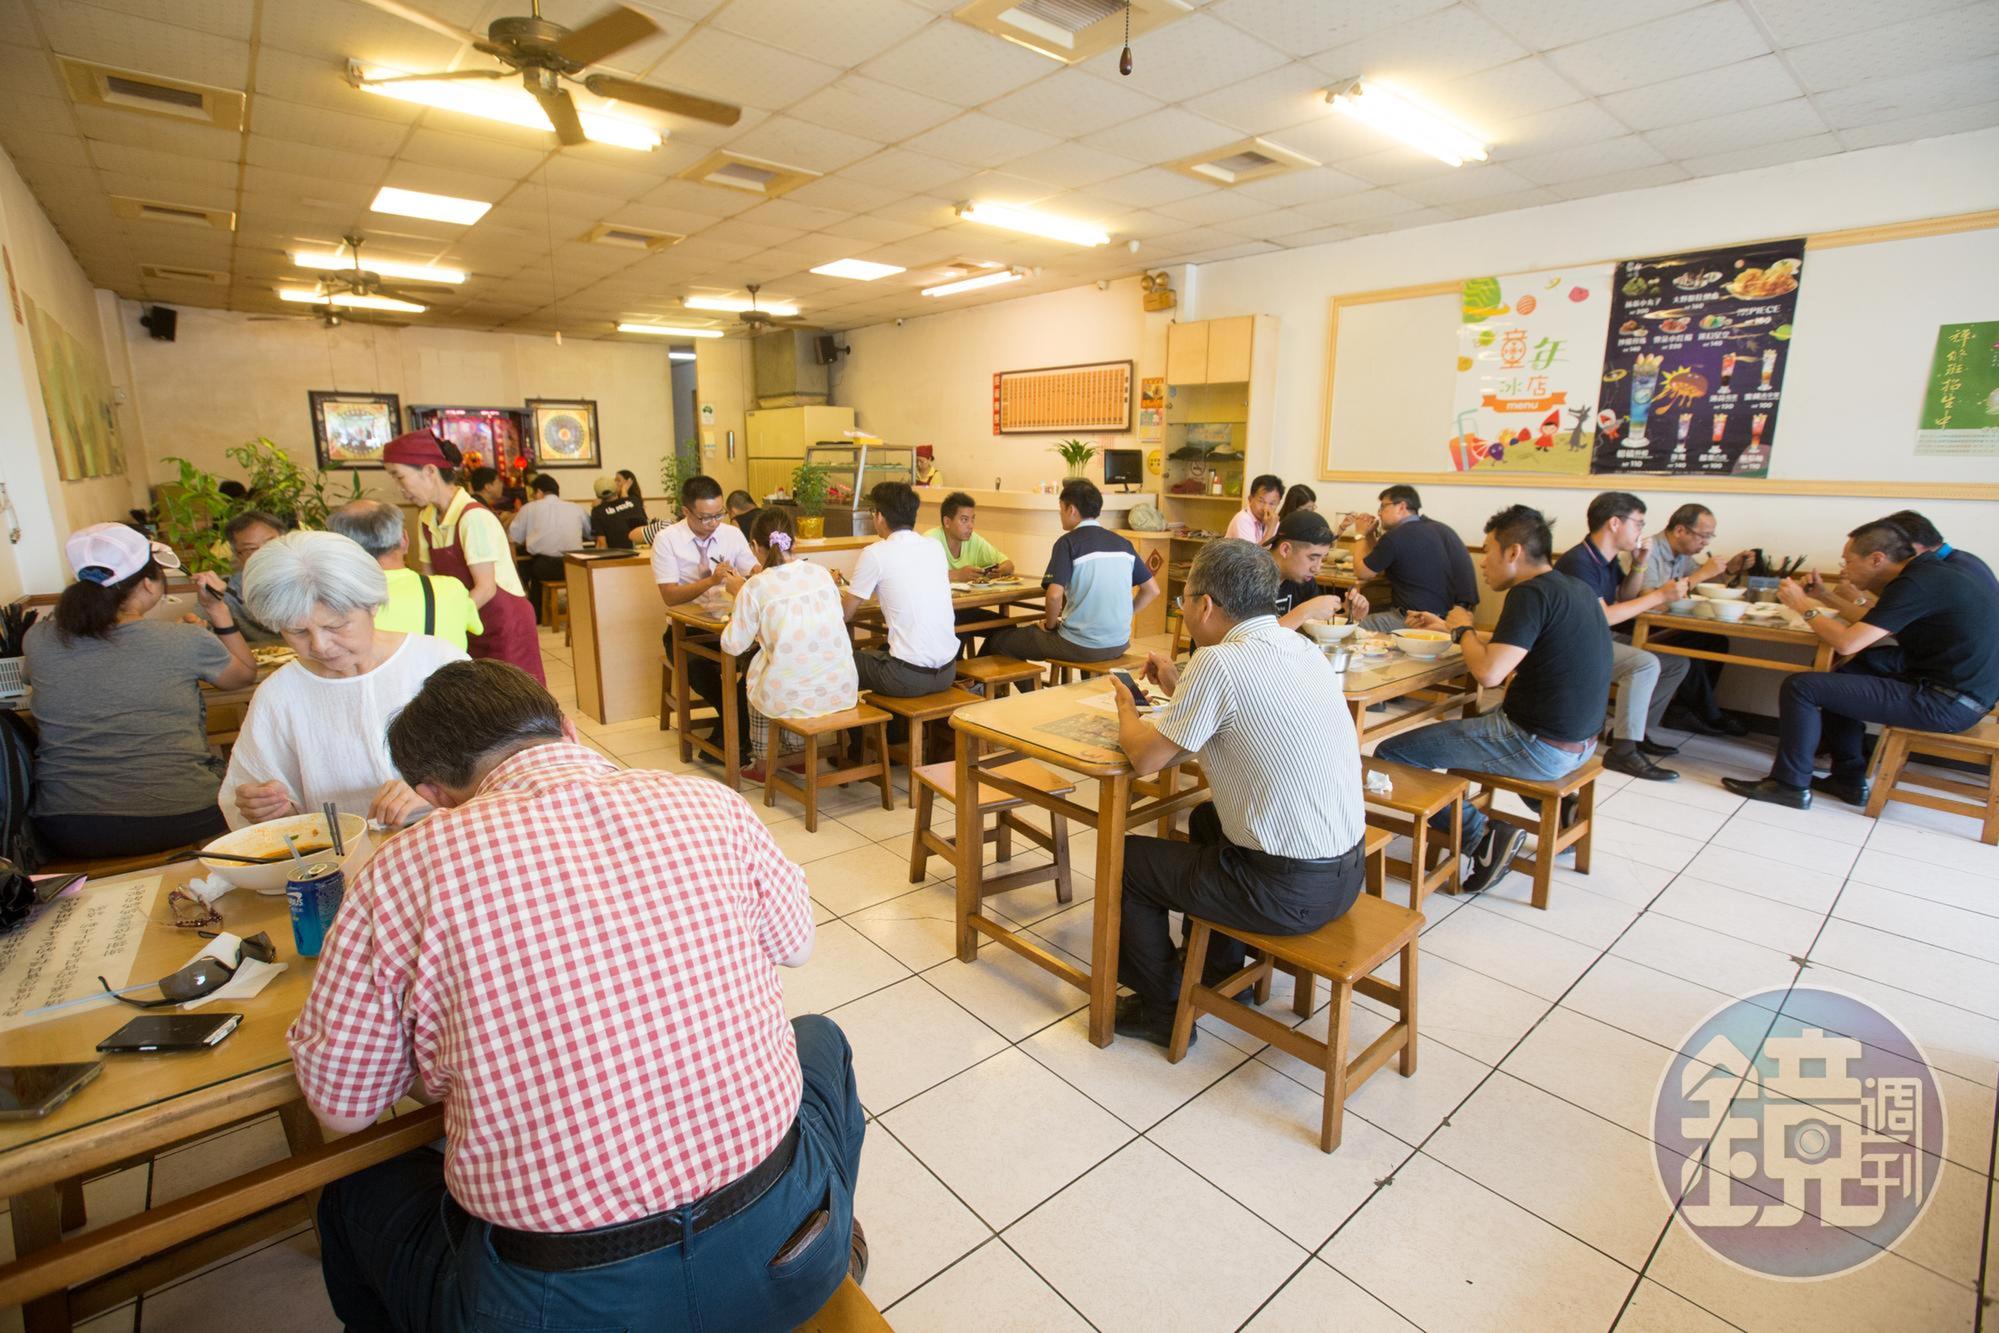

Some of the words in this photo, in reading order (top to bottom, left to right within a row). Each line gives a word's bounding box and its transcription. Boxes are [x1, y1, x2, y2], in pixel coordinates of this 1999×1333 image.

[1499, 328, 1570, 370] 童年
[1499, 375, 1549, 396] 冰店
[1506, 401, 1540, 410] menu
